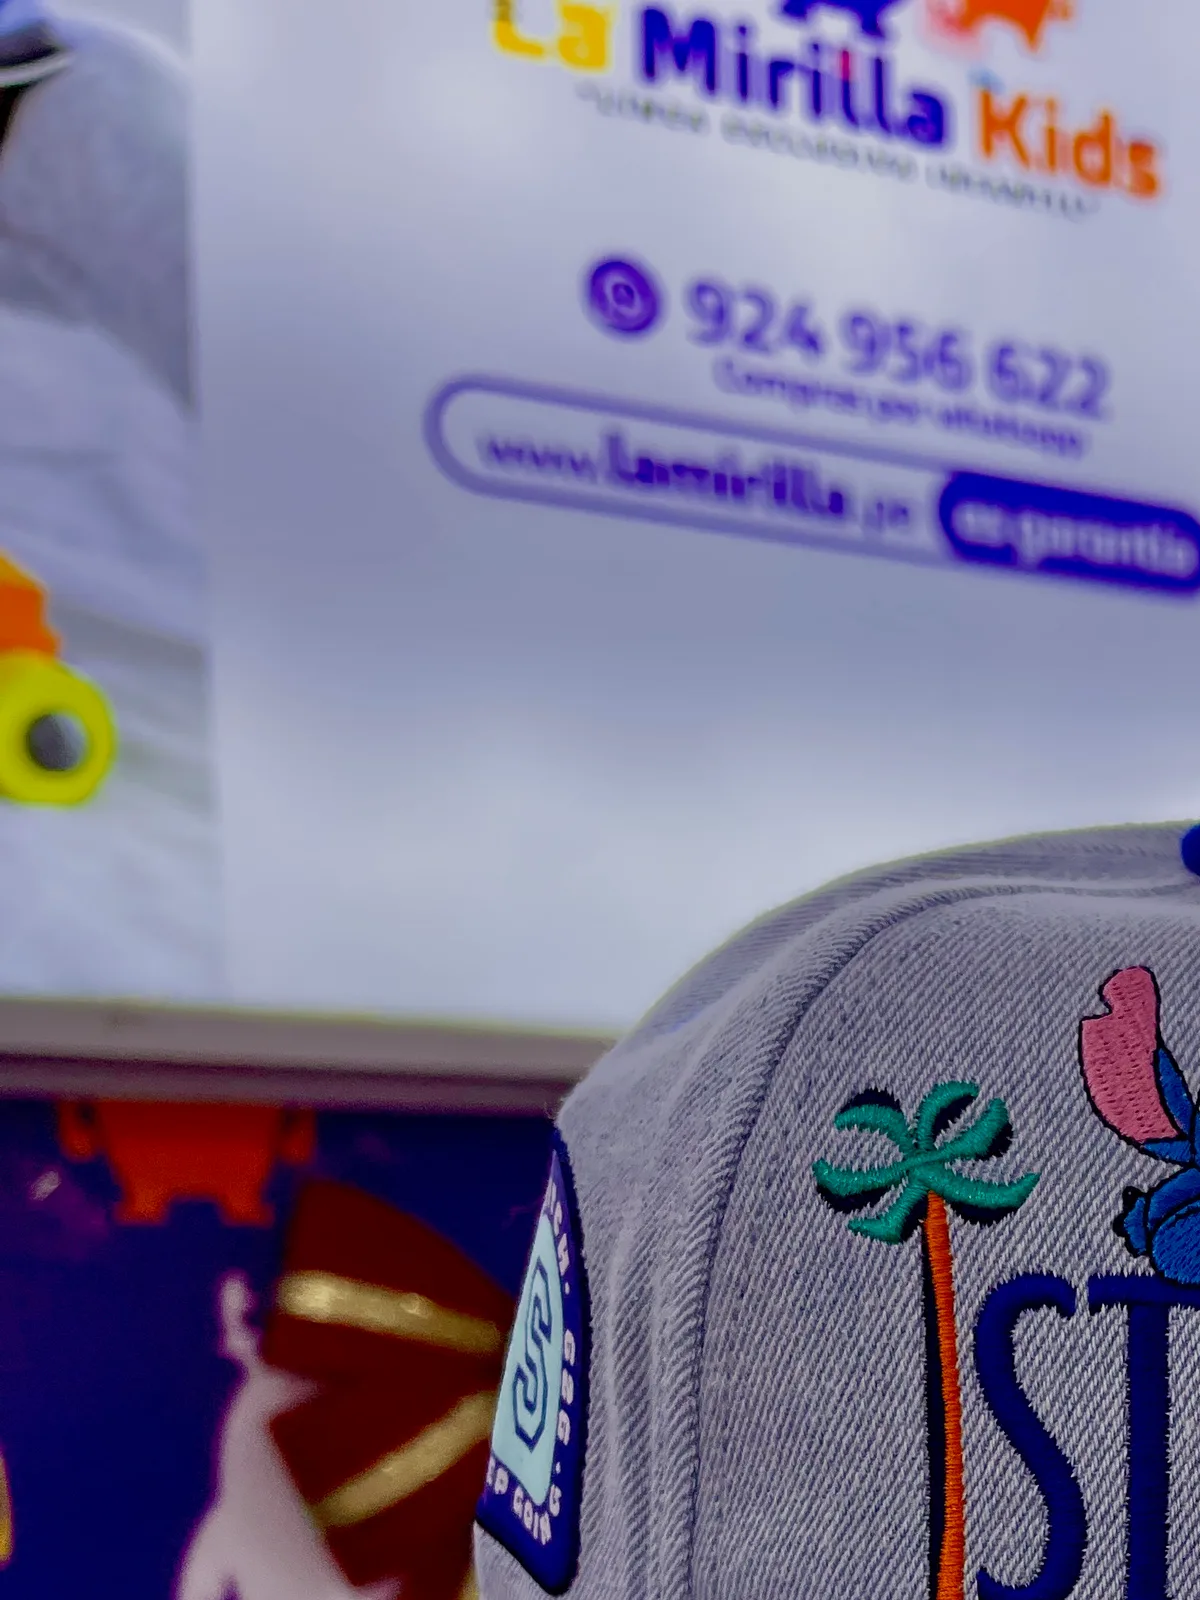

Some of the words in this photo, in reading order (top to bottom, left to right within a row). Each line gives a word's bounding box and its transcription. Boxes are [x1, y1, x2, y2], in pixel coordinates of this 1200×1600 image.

[490, 0, 609, 69] La
[639, 4, 951, 148] Mirilla
[977, 86, 1162, 198] Kids
[686, 282, 825, 359] 924
[840, 311, 974, 394] 956
[985, 341, 1113, 423] 622
